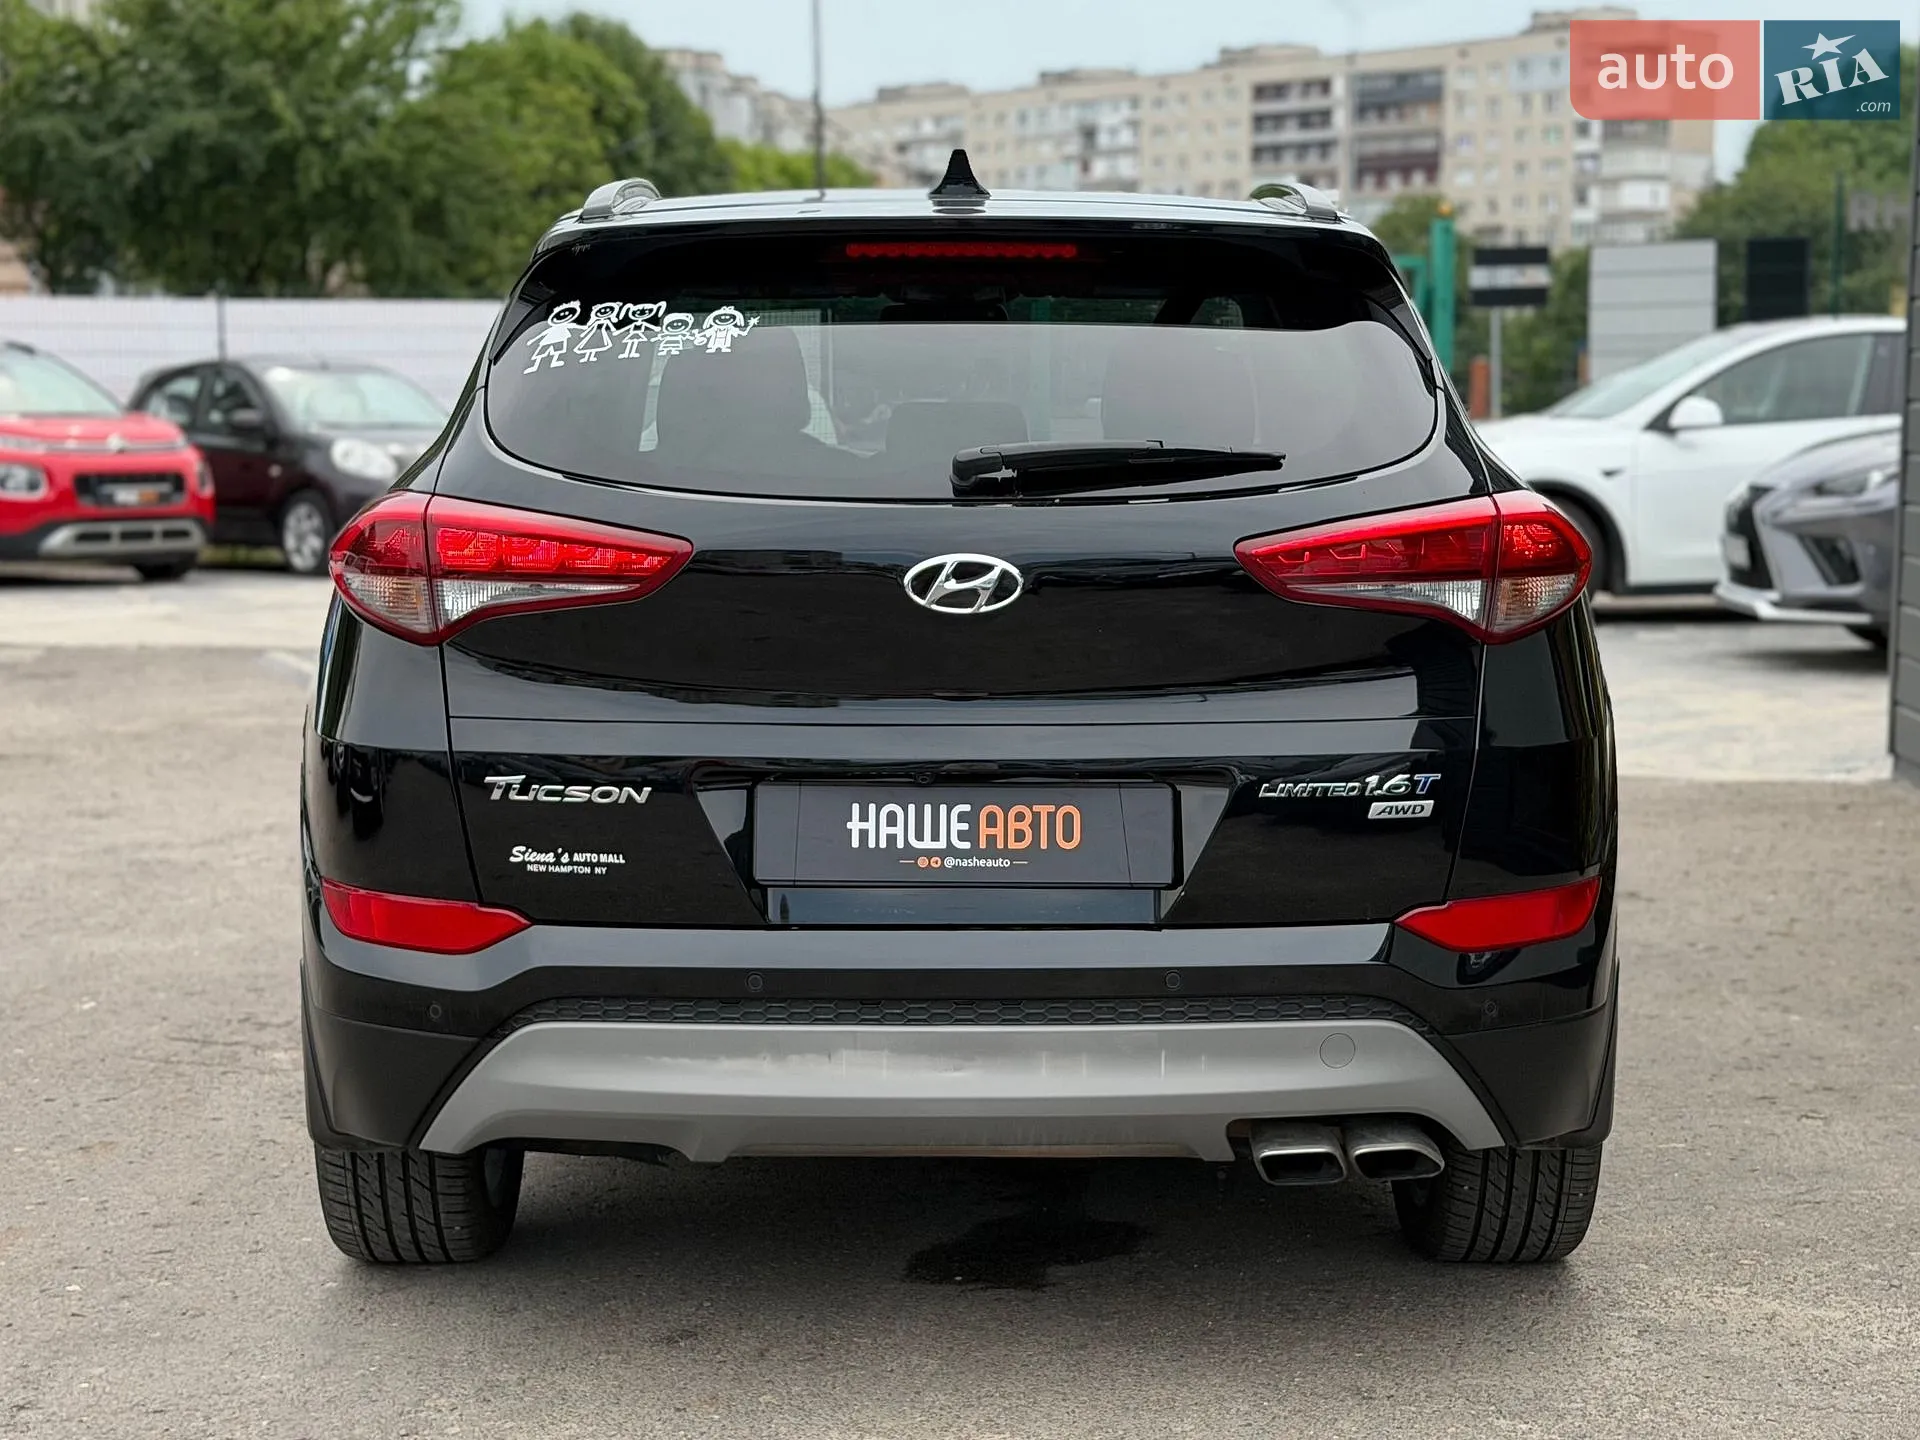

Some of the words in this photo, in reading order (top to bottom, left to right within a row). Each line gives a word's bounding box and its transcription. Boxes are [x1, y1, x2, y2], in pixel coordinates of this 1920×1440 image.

[484, 774, 652, 804] TUCSON
[1259, 782, 1363, 798] LIMITED
[1376, 804, 1426, 816] AWD
[846, 803, 972, 849] НАШЕ
[979, 804, 1081, 850] АВТО
[509, 845, 570, 863] Siena's
[573, 852, 598, 862] AUTO
[600, 854, 626, 863] MALL
[943, 856, 1011, 868] @nasheauto
[526, 863, 547, 872] NEW
[548, 864, 591, 874] HAMPTON
[594, 866, 607, 875] NY
